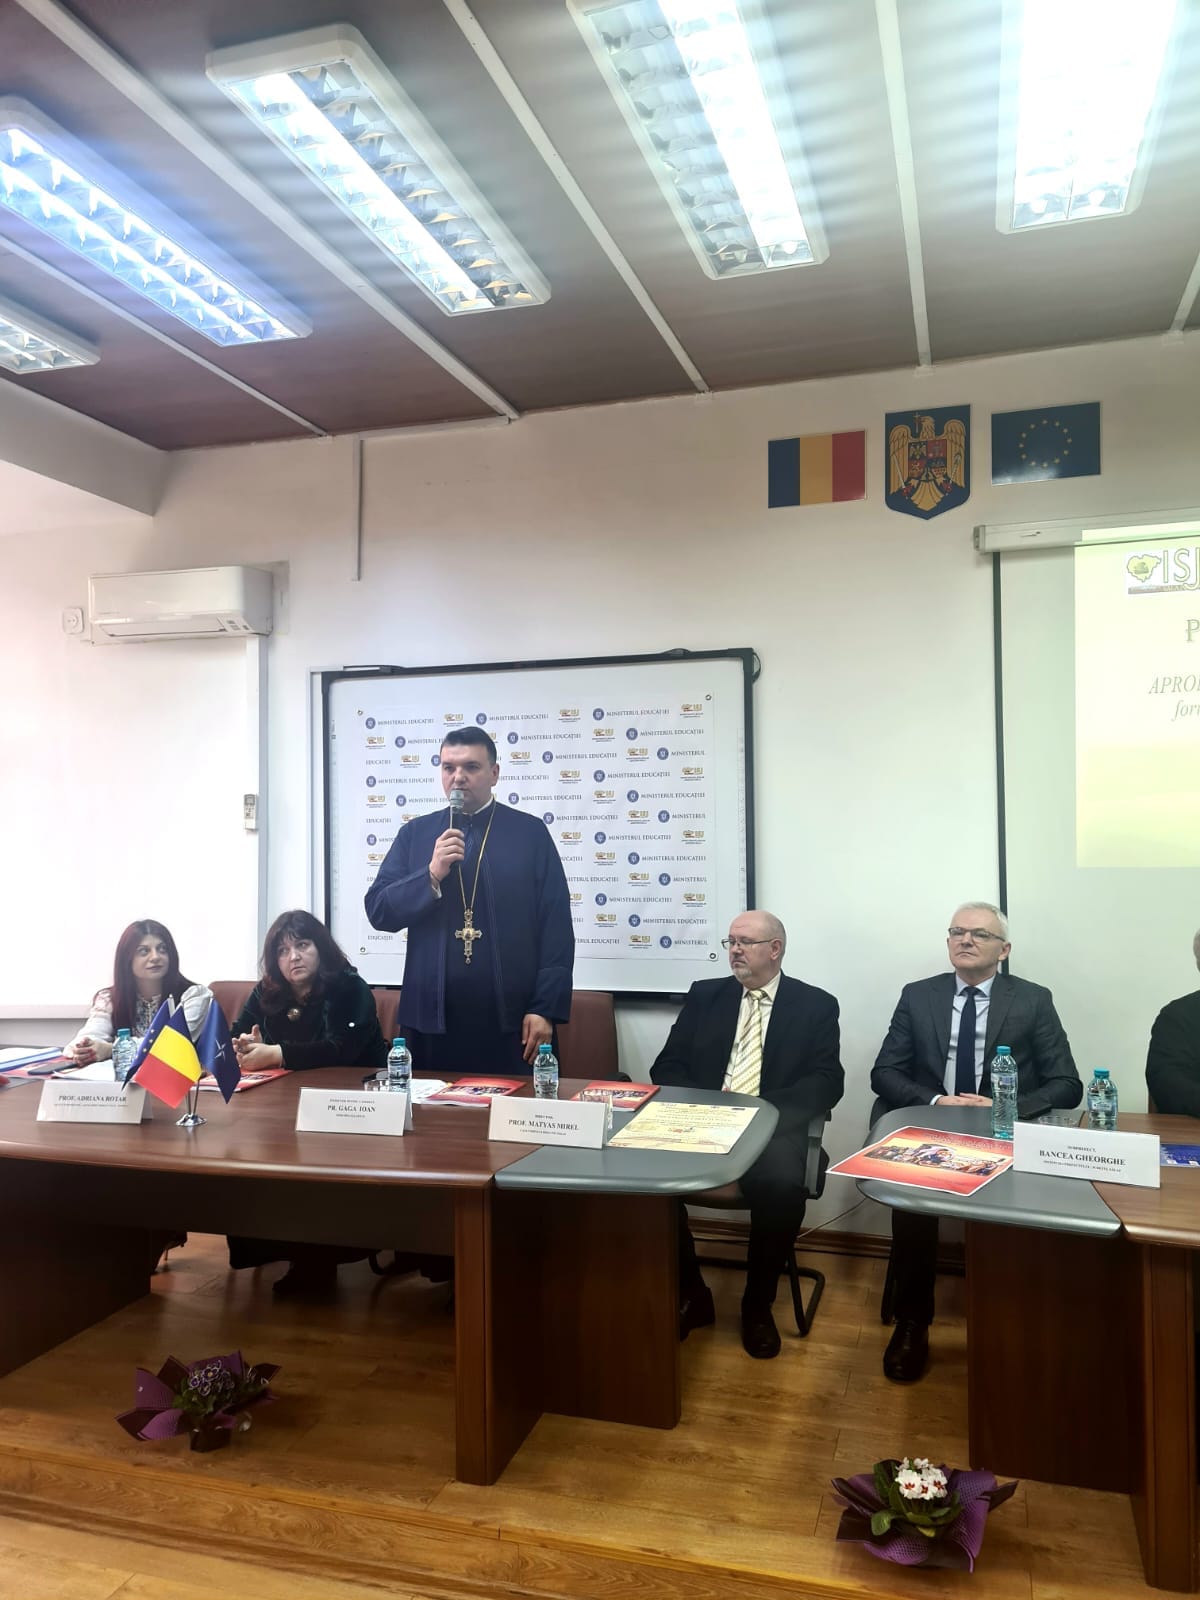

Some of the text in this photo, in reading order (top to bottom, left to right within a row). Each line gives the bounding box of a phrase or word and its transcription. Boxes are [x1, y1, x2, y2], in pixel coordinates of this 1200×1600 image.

[1163, 546, 1200, 590] ISJ
[528, 1120, 556, 1128] MATYAS
[556, 1122, 580, 1130] MIREL
[1040, 1150, 1126, 1166] BANCEA GHEORGHE
